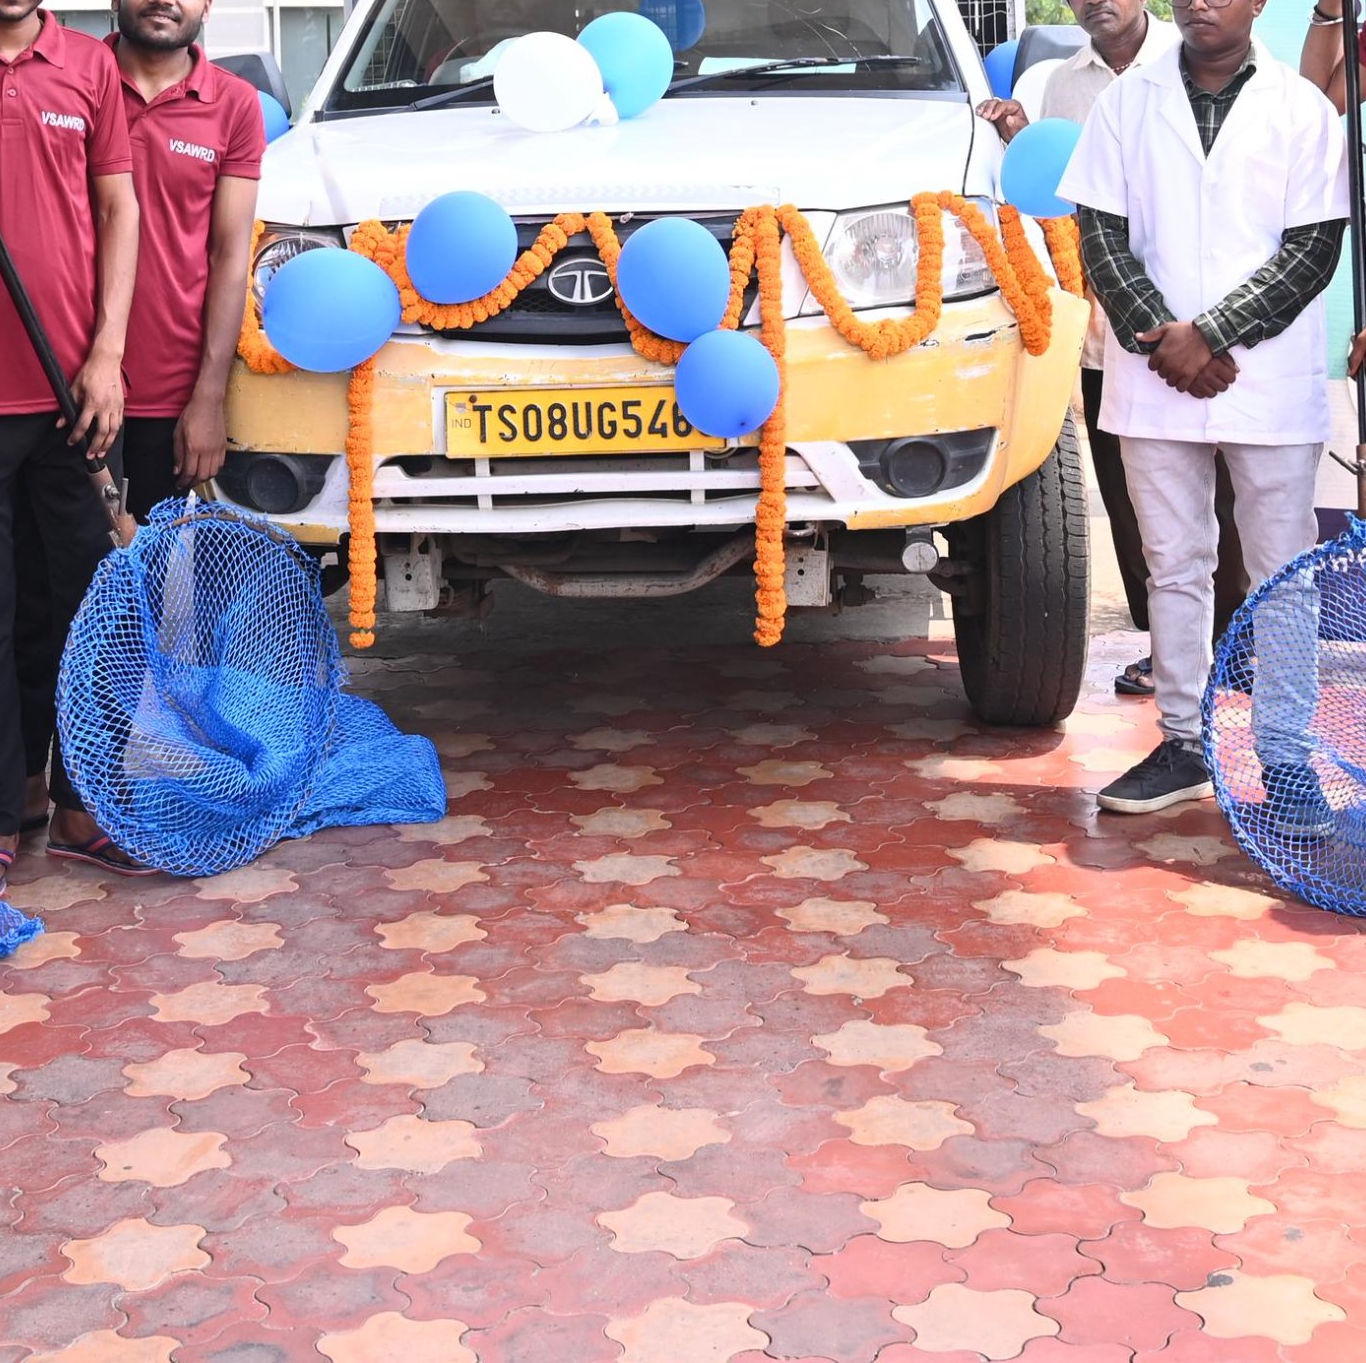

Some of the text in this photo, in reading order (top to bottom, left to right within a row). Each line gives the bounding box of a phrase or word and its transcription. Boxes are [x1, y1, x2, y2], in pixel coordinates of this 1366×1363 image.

[41, 110, 85, 132] VSAWRD
[169, 138, 215, 163] VSAWRD
[451, 418, 472, 429] IND
[472, 399, 712, 443] TS08UG546
